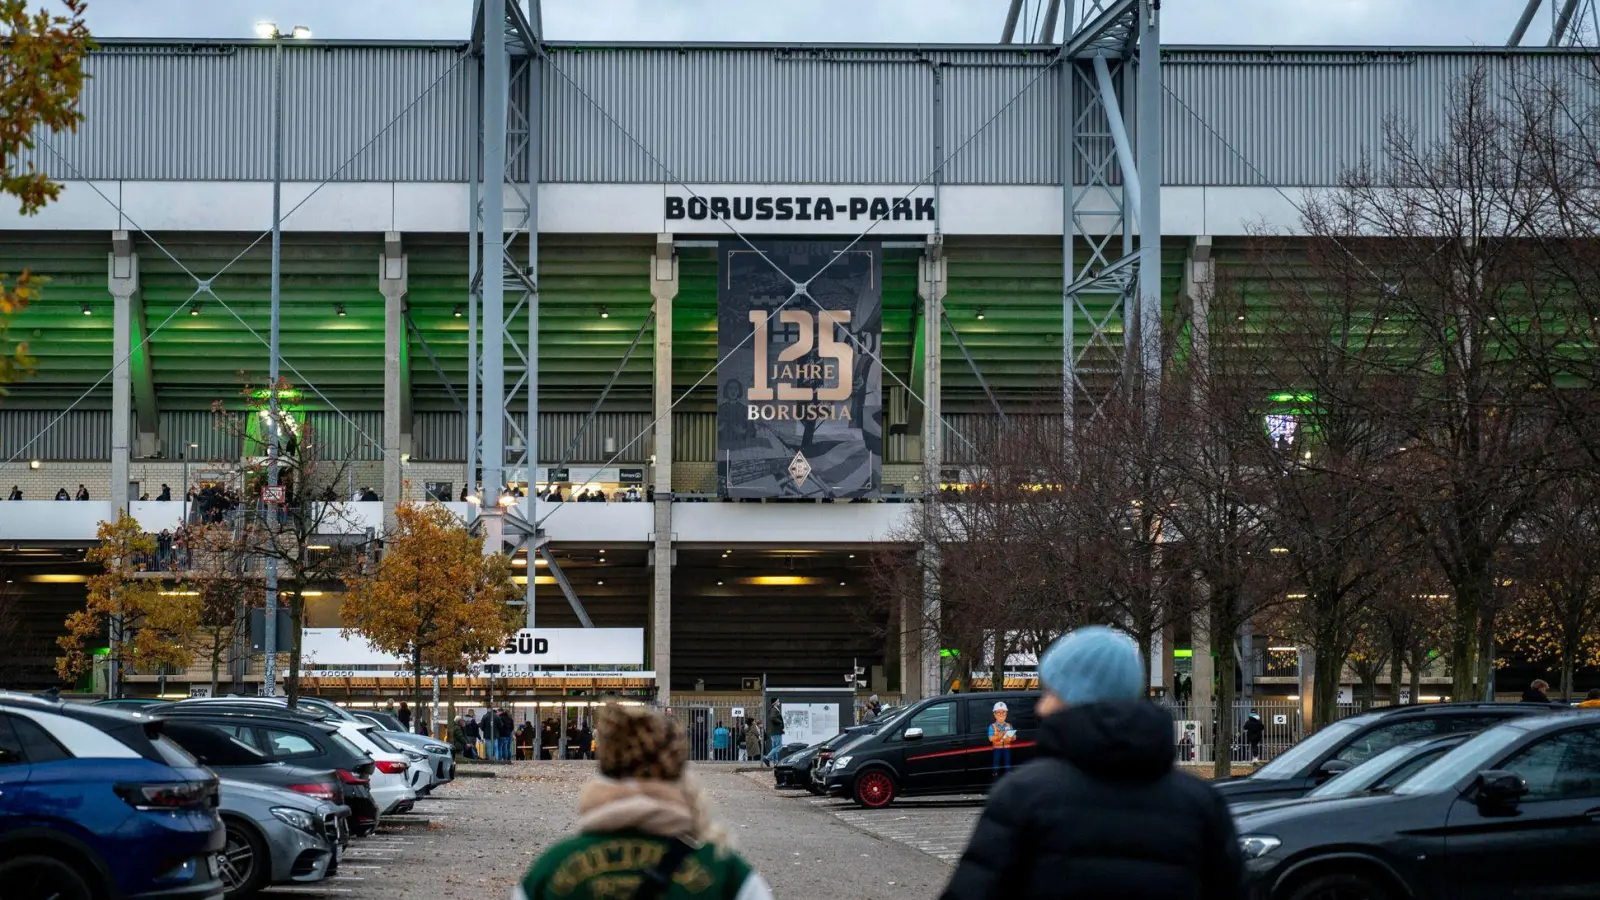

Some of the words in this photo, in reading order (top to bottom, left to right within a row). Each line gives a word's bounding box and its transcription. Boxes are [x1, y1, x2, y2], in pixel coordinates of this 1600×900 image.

[665, 196, 936, 221] BORUSSIA-PARK
[747, 309, 854, 401] 125
[771, 364, 835, 380] JAHRE
[747, 404, 853, 420] BORUSSIA
[504, 633, 549, 654] SÜD
